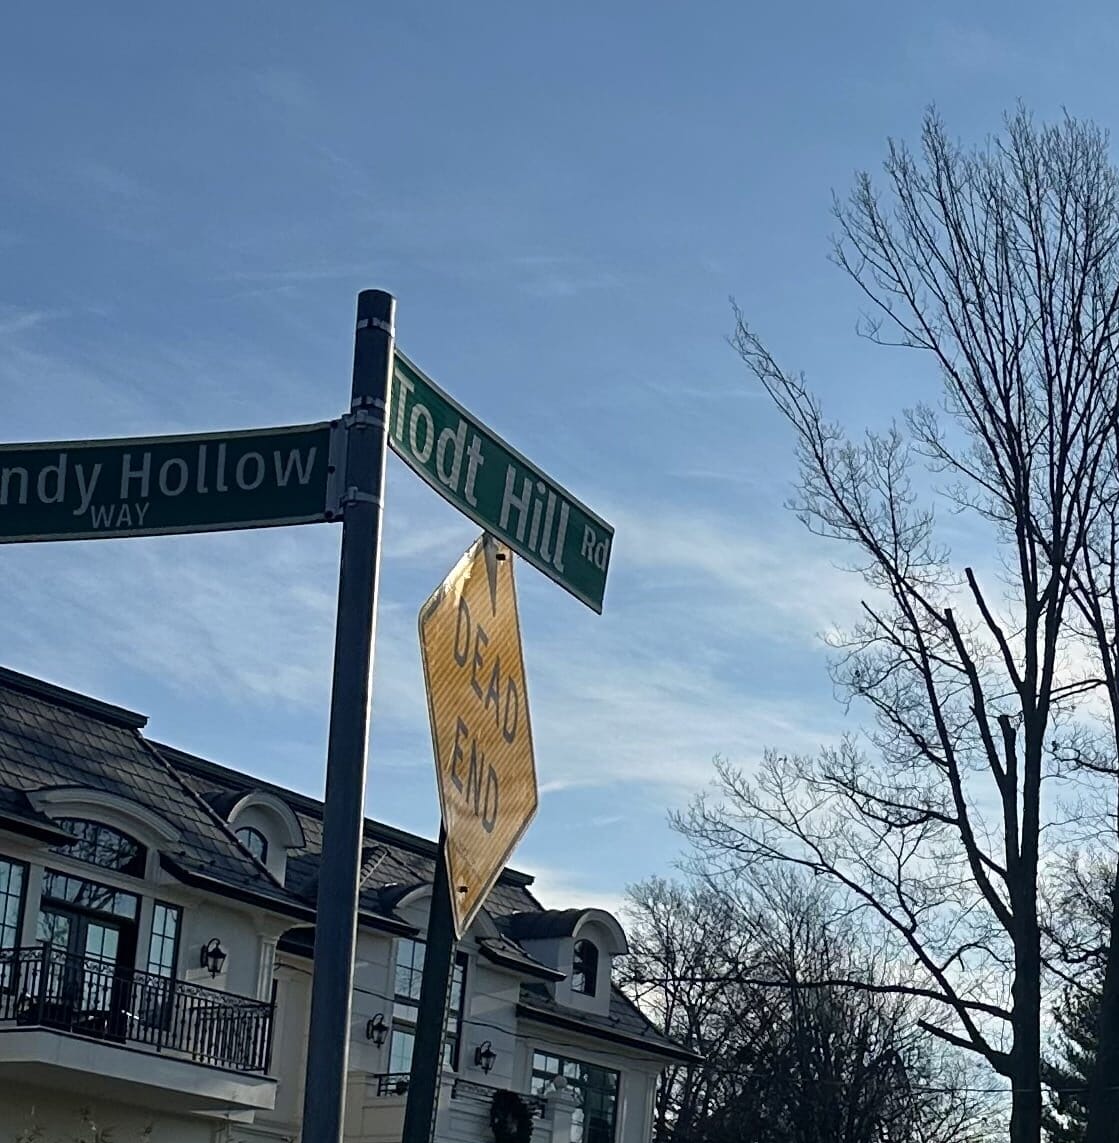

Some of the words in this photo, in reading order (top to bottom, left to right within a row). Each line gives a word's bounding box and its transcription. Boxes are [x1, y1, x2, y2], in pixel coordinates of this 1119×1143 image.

[91, 502, 149, 528] WAY
[120, 443, 317, 500] Hollow
[392, 368, 485, 507] Todt
[500, 464, 570, 573] Hill
[581, 525, 610, 572] Rd
[454, 596, 518, 744] DEAD
[451, 716, 498, 834] END
